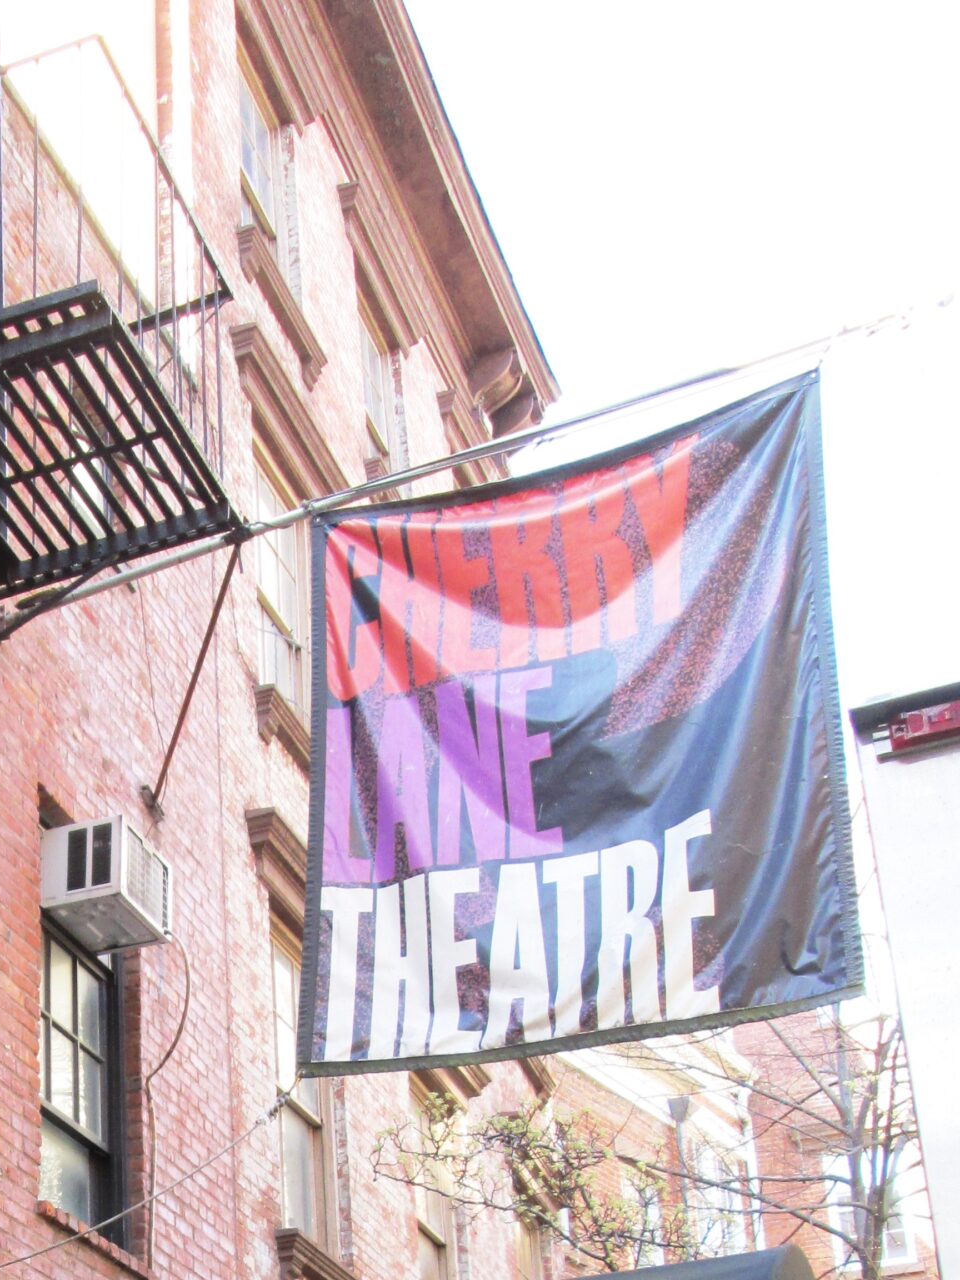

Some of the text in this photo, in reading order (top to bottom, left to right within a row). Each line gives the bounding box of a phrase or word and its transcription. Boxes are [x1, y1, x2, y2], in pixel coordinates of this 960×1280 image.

[326, 434, 700, 701] CHERRY
[322, 667, 563, 883] LANE
[311, 810, 720, 1062] THEATRE
